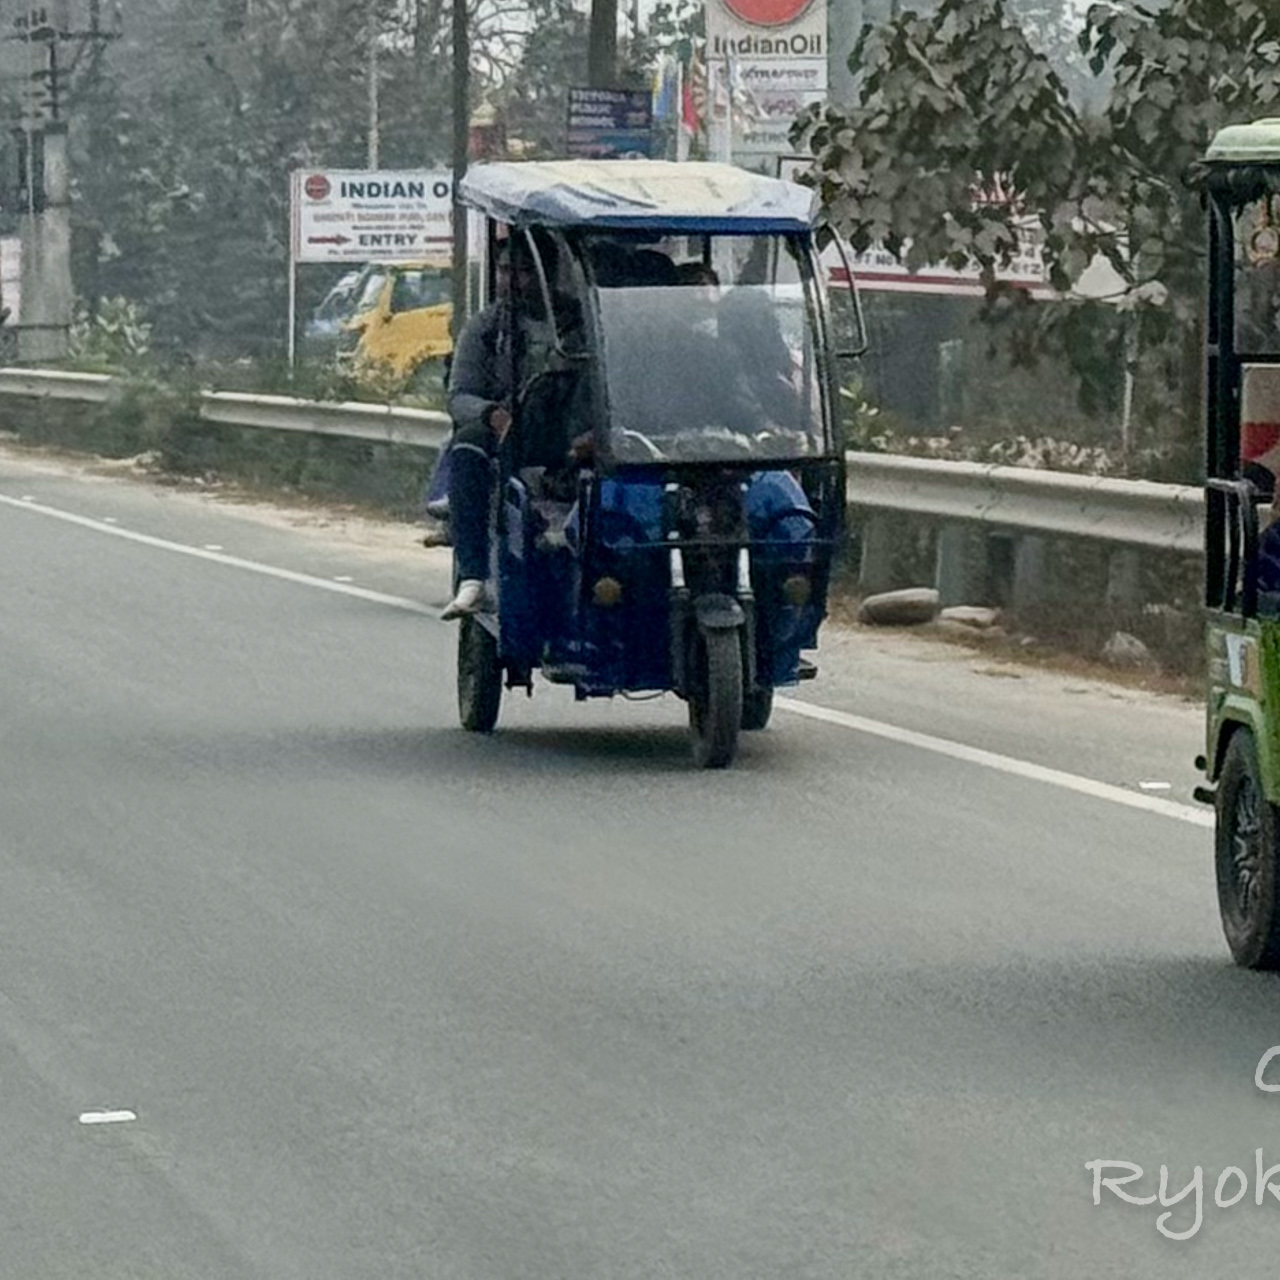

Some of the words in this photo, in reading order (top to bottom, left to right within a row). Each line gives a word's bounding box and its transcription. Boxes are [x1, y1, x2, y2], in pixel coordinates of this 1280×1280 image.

[714, 33, 822, 55] IndianOil
[340, 181, 425, 199] INDIAN
[358, 233, 418, 247] ENTRY
